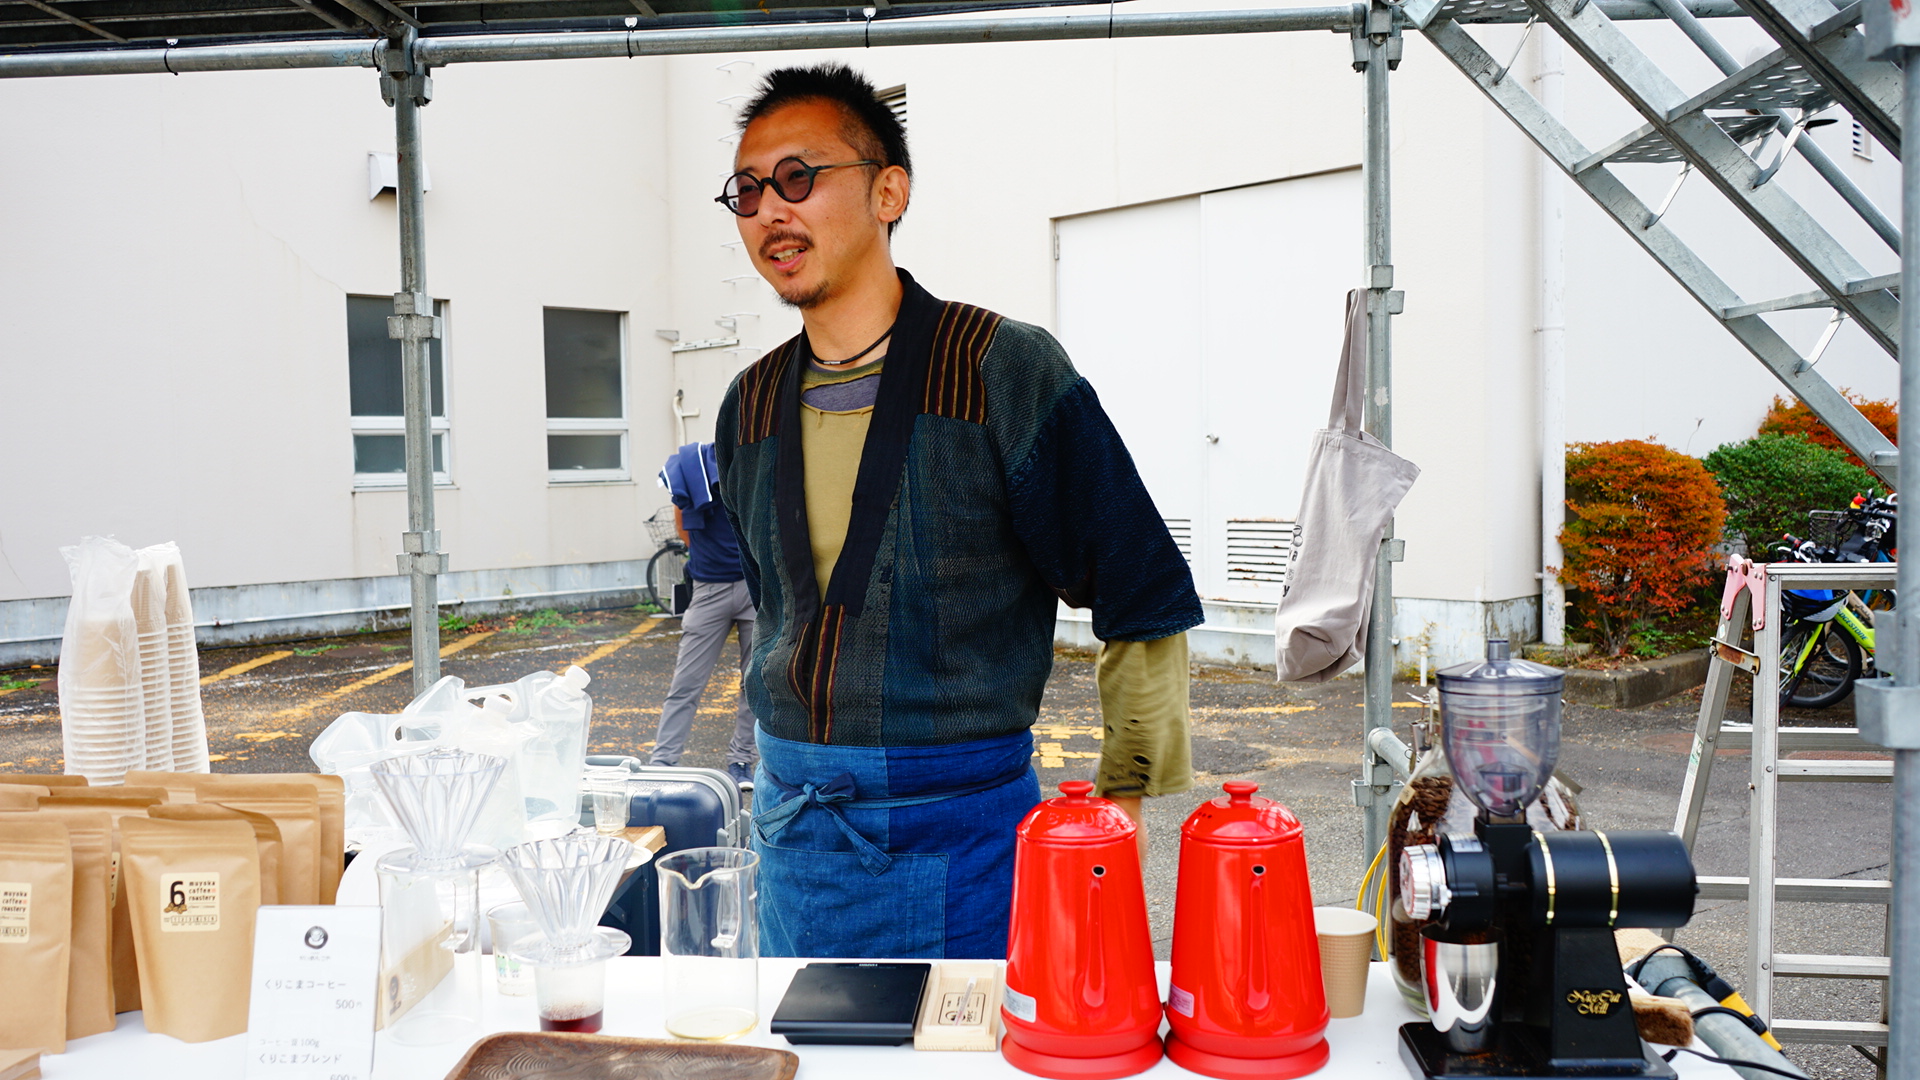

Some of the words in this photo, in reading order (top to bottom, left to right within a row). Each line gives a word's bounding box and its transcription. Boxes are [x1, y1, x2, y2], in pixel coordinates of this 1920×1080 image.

[170, 880, 186, 908] 6
[265, 979, 346, 989] くりこまコーヒー
[259, 1053, 342, 1064] くりこまブレンド
